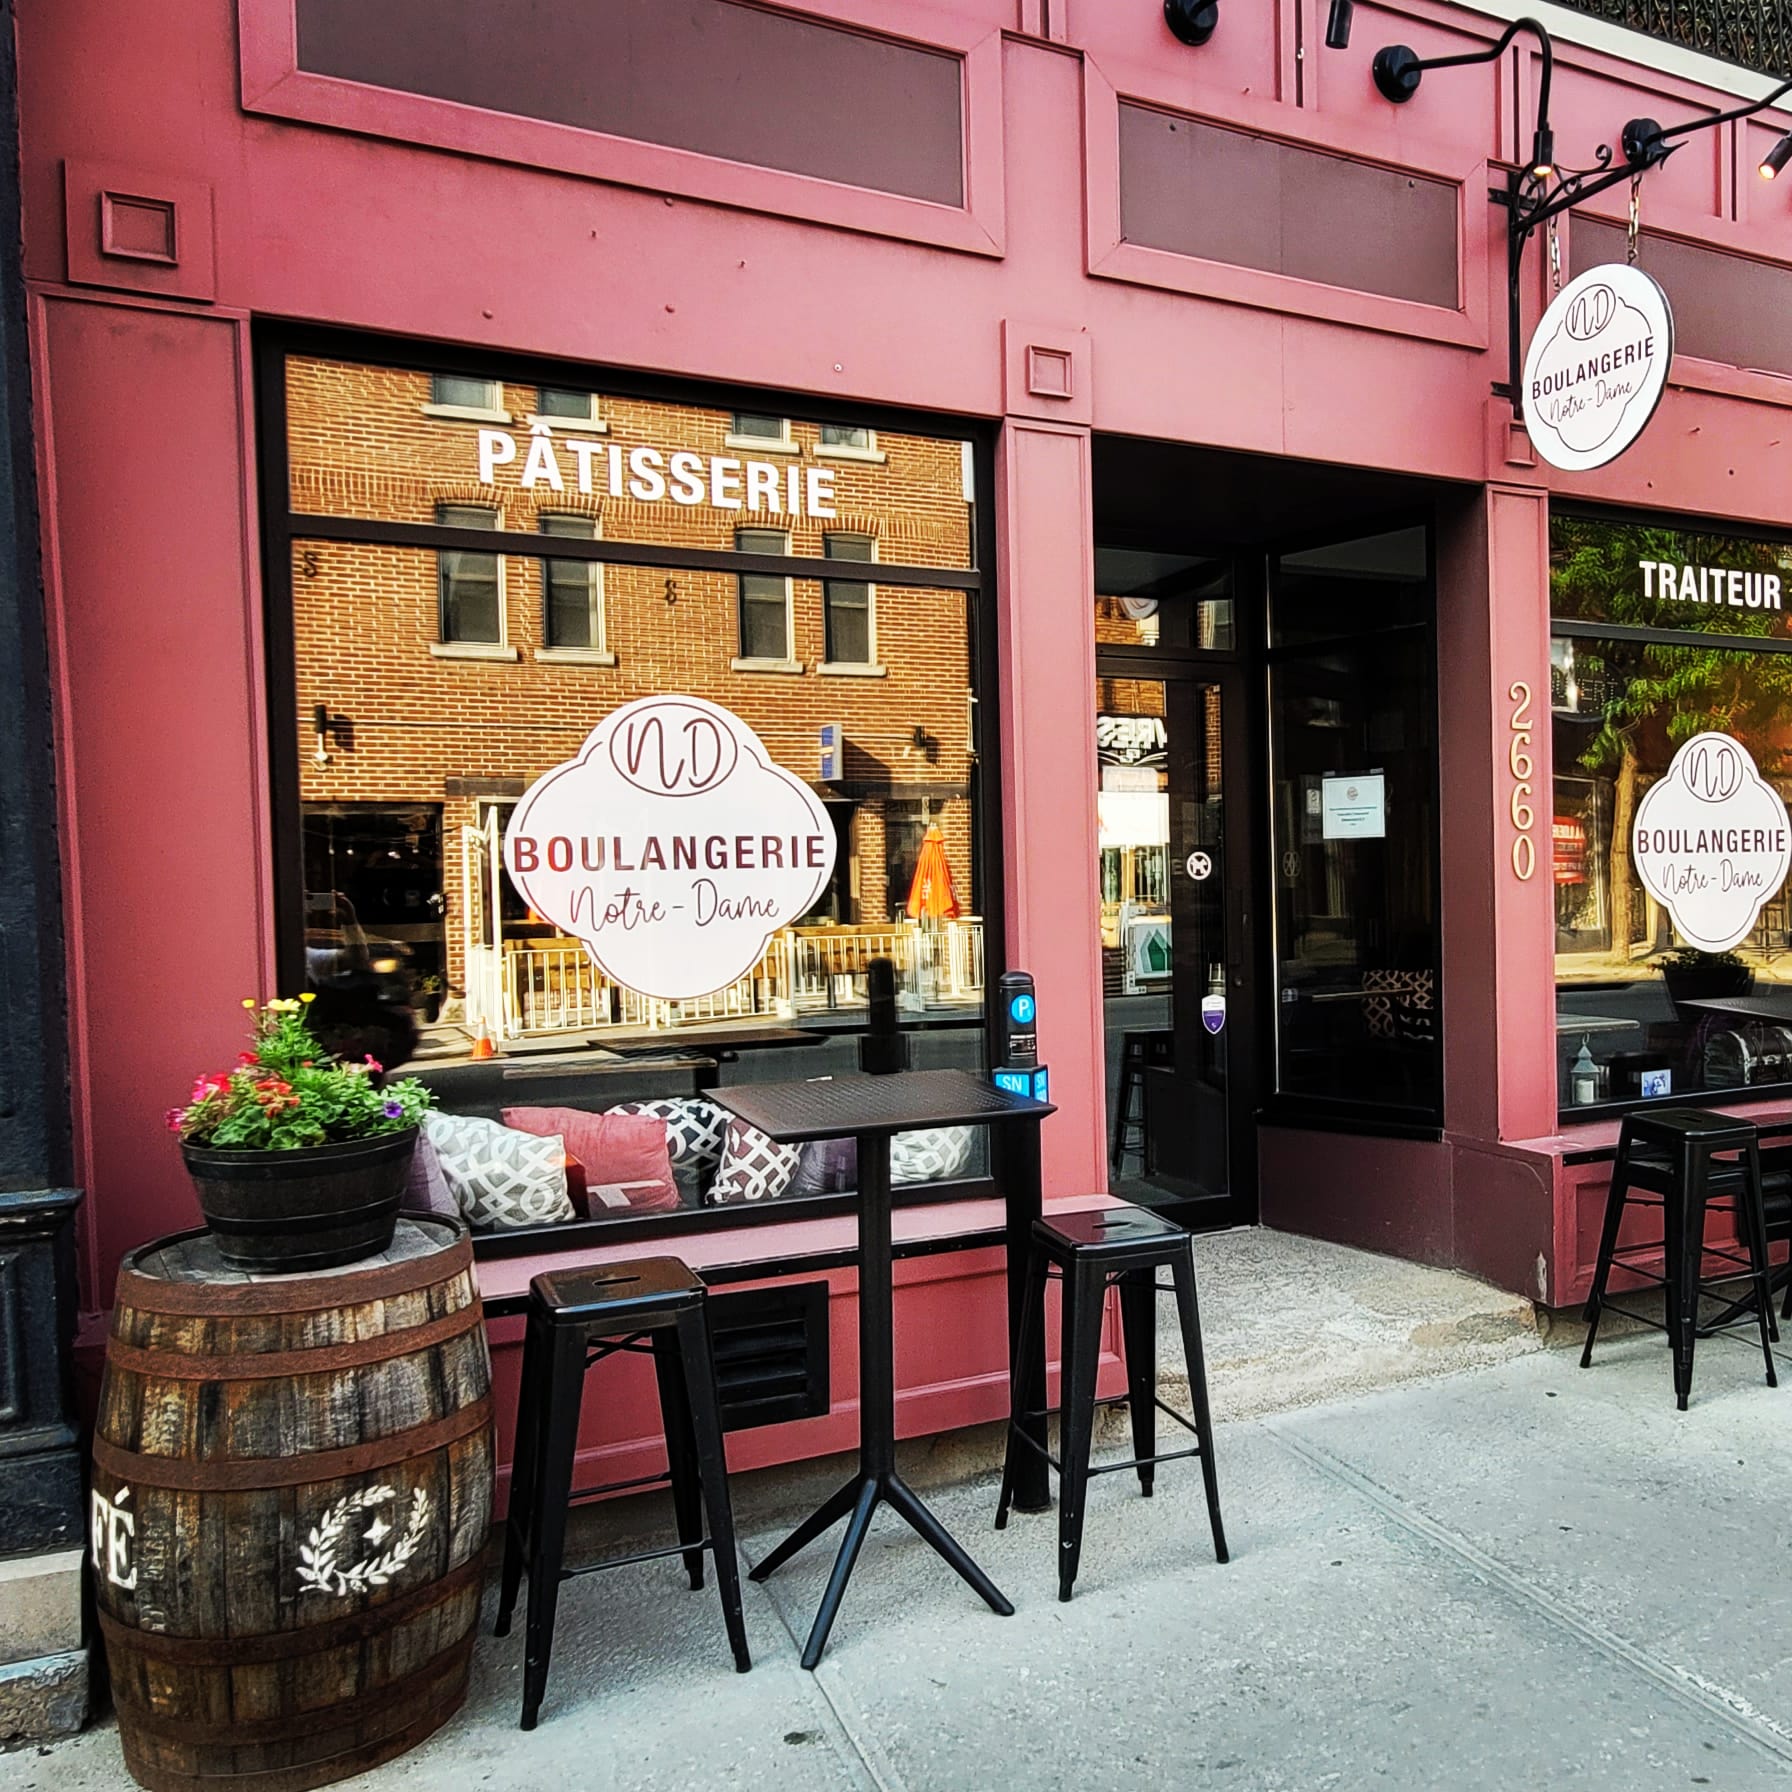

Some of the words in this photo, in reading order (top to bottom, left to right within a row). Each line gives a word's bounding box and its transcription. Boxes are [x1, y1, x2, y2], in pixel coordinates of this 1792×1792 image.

[1532, 336, 1655, 400] BOULANGERIE
[1549, 379, 1633, 423] Notre-Dame
[479, 423, 836, 519] PÂTISSERIE
[1639, 560, 1782, 610] TRAITEUR
[1508, 681, 1537, 882] 2660
[513, 833, 826, 874] BOULANGERIE
[1638, 827, 1787, 855] BOULANGERIE
[1662, 857, 1763, 894] Notre-Dame
[569, 876, 780, 932] Notre-Dame
[1018, 998, 1029, 1018] P
